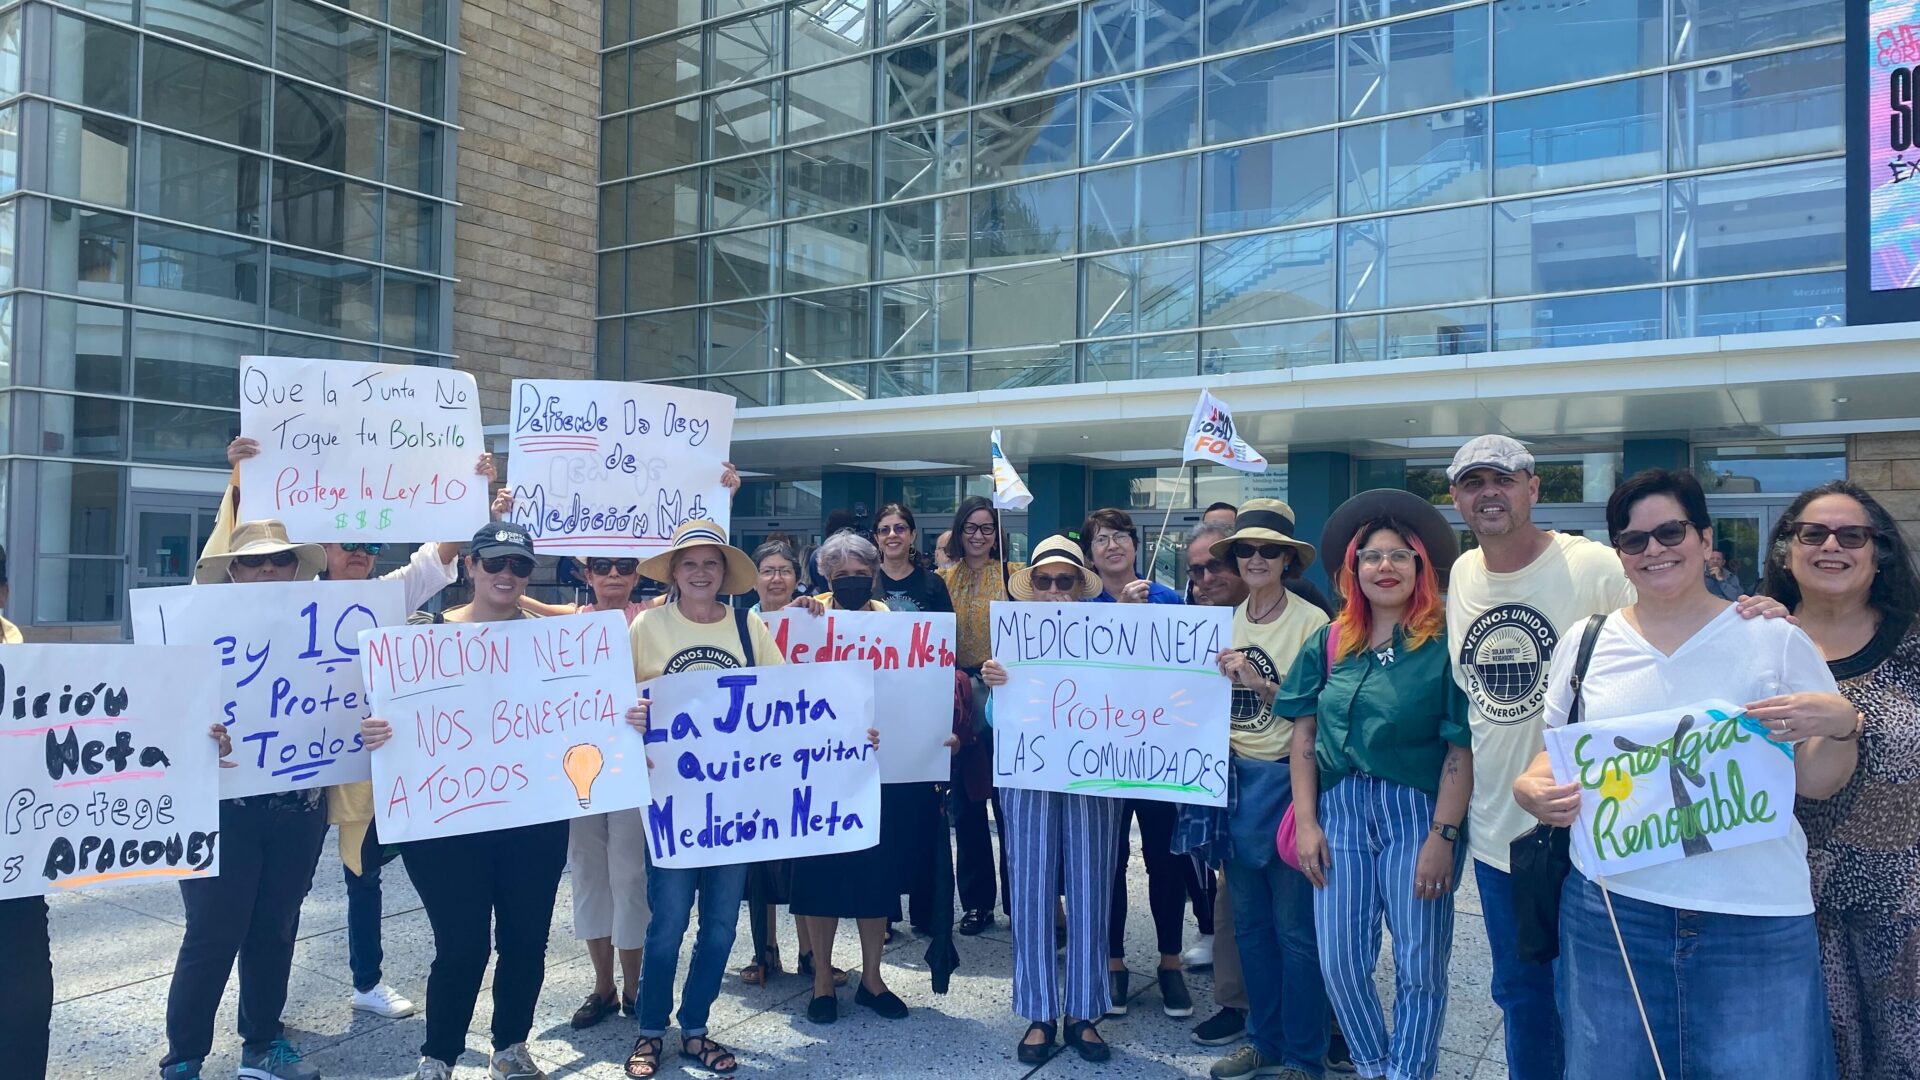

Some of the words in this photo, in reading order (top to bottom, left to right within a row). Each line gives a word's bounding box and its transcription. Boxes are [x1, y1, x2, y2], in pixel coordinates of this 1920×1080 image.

[243, 366, 304, 408] Que
[322, 371, 337, 406] la
[352, 371, 415, 402] Junta
[435, 378, 467, 405] No
[272, 413, 341, 455] Toque
[356, 418, 378, 446] tu
[390, 418, 464, 450] Bolsillo
[515, 383, 608, 434] Defiende
[624, 399, 650, 436] la
[664, 402, 709, 446] ley
[605, 442, 637, 474] de
[275, 466, 349, 511] Protege
[360, 467, 373, 500] la
[382, 464, 420, 508] Ley
[425, 474, 467, 505] 10
[510, 484, 649, 539] Medición
[533, 622, 611, 673] NETA
[1150, 617, 1221, 666] NETA
[1464, 609, 1508, 651] VECINOS
[1511, 608, 1554, 647] UNIDOS
[667, 649, 703, 676] ECINOS
[416, 705, 473, 757] NOS
[491, 689, 620, 745] BENEFICIA
[642, 687, 702, 746] La
[713, 674, 837, 734] Junta
[1052, 678, 1171, 737] Protege
[242, 725, 364, 769] Todos
[677, 749, 782, 783] Quiere
[793, 738, 874, 780] quitar
[996, 729, 1046, 777] LAS
[6, 788, 175, 835] Protege
[388, 775, 410, 818] A
[418, 764, 529, 811] TODOS
[1593, 759, 1777, 861] Renovable
[647, 792, 779, 860] Medición
[791, 785, 864, 838] Neta
